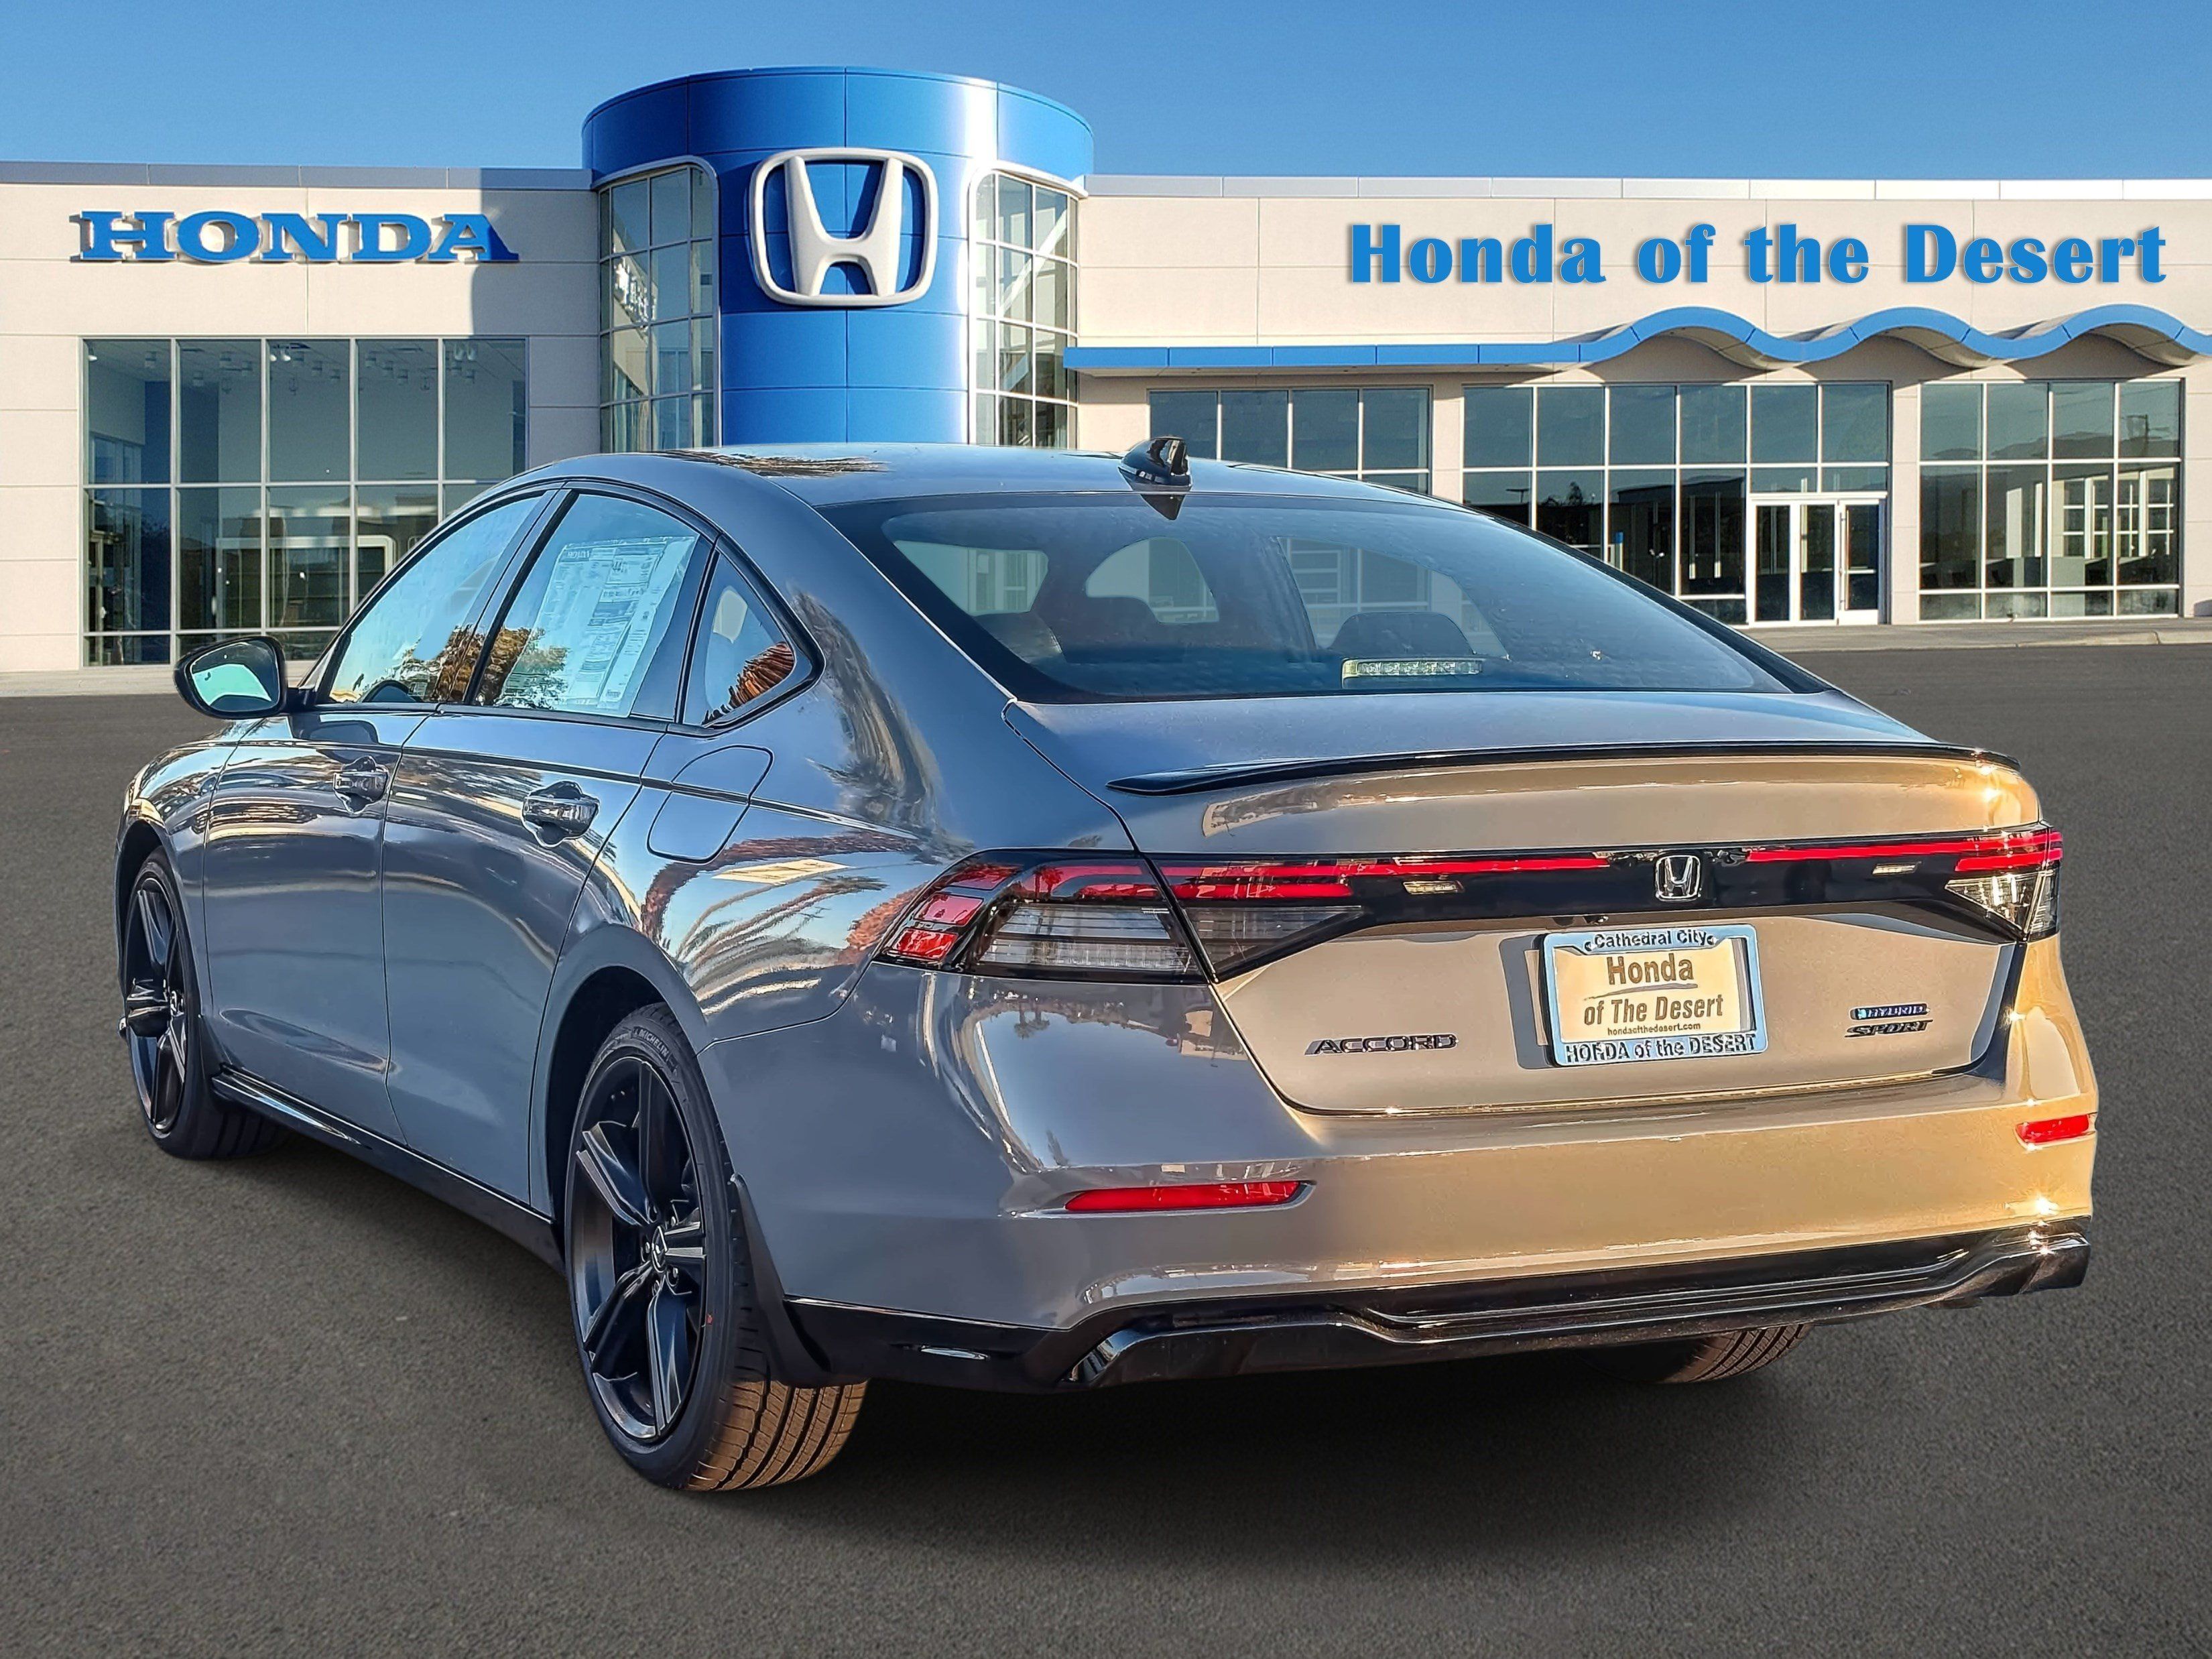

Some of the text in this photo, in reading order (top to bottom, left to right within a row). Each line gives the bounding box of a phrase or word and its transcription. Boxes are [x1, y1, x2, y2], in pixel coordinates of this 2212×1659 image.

[80, 210, 519, 263] HONDA
[1351, 223, 2166, 283] Honda of the Desert
[1594, 929, 1707, 949] Cathedral City
[1607, 953, 1695, 985] Honda
[1584, 994, 1723, 1026] of The Desert
[1844, 1020, 1933, 1037] SPORT
[1304, 1034, 1458, 1055] ACCORD
[1566, 1033, 1756, 1063] HONDA of the DESERT
